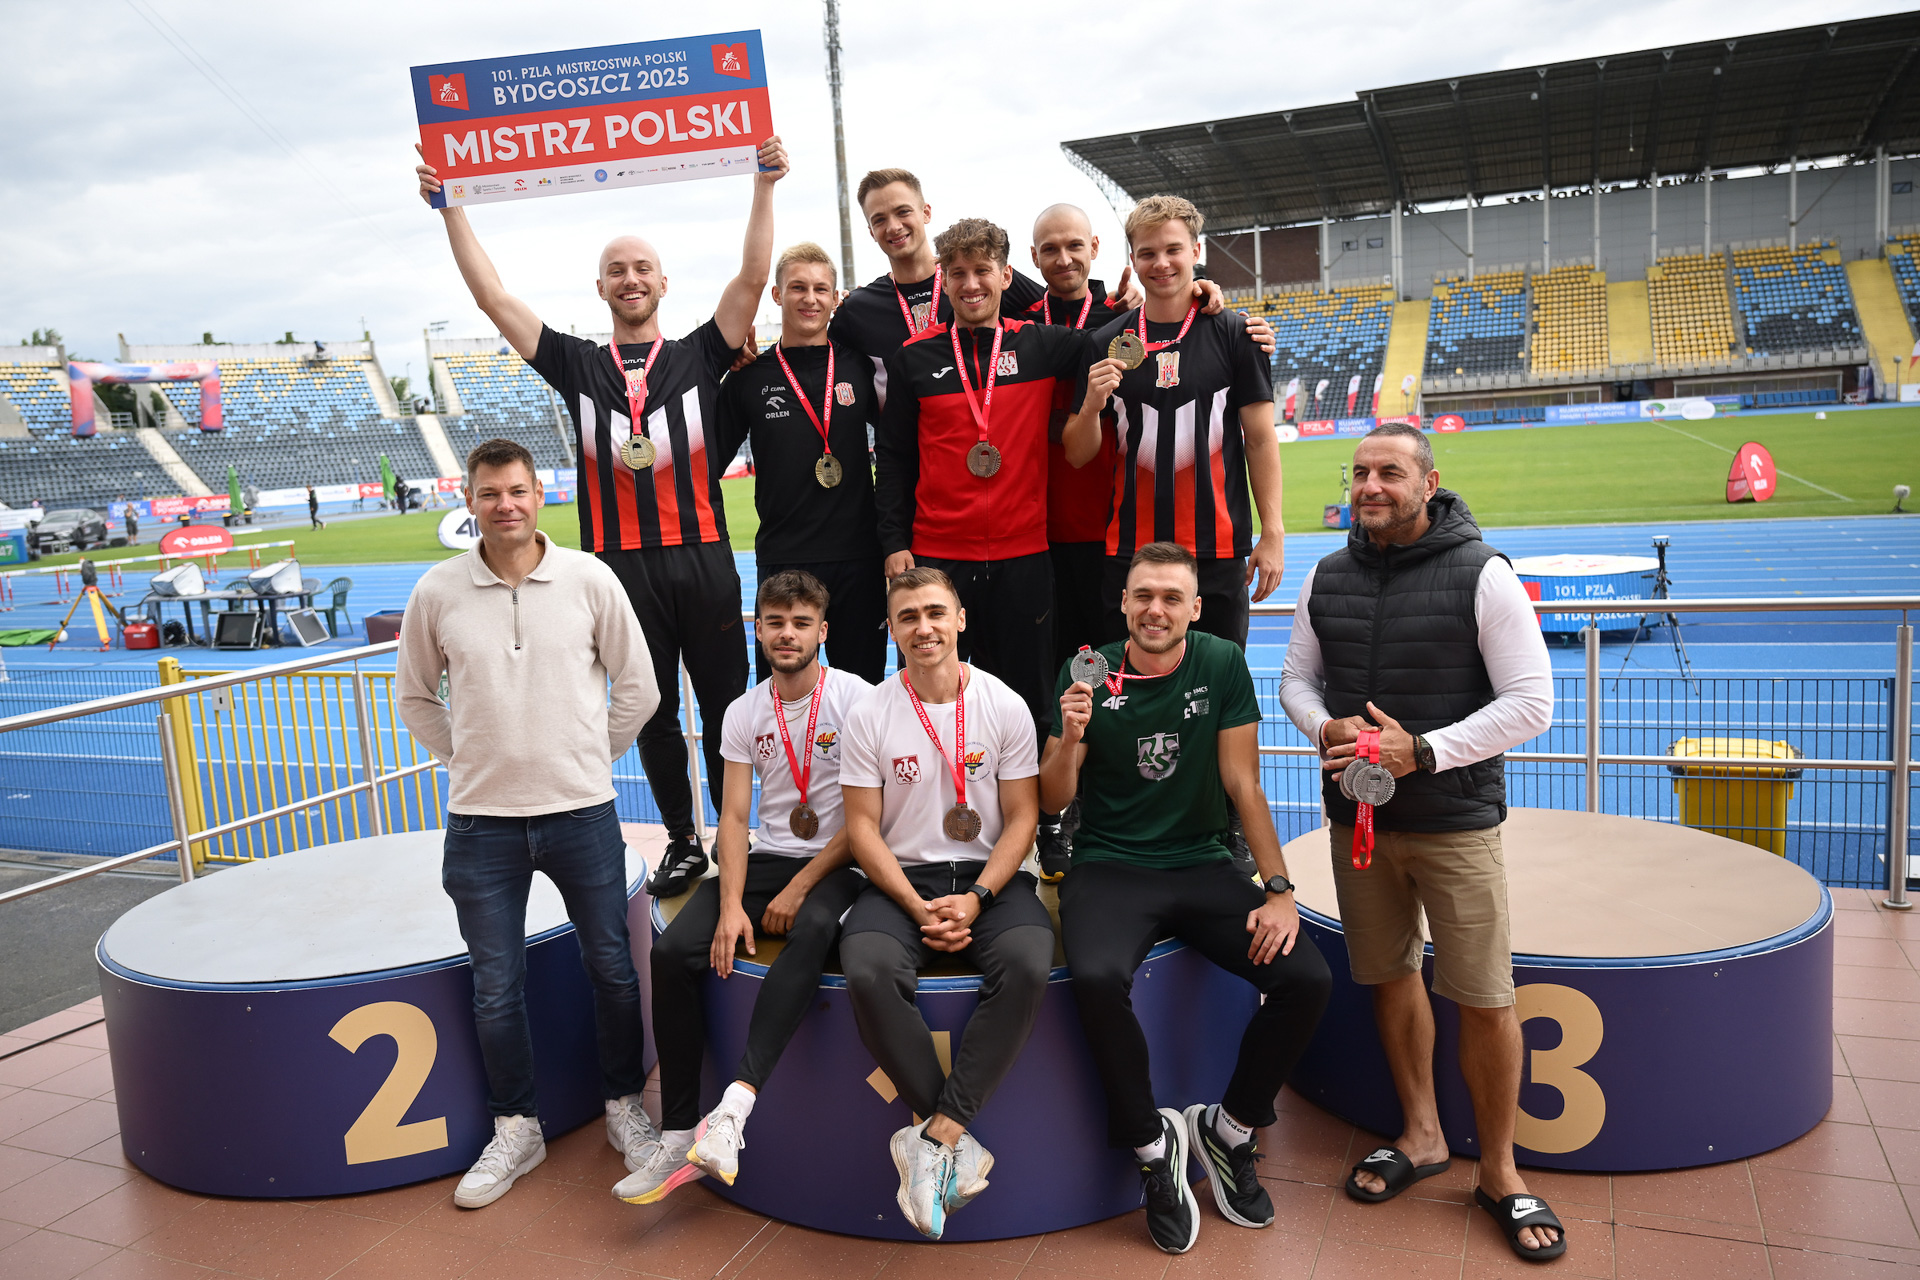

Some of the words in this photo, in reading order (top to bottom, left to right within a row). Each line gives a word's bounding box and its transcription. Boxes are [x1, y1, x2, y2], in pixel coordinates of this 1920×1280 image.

[491, 70, 518, 83] 101.
[521, 65, 552, 80] PZLA
[556, 55, 642, 76] MISTRZOSTWA
[644, 50, 687, 65] POLSKI
[493, 73, 632, 106] BYDGOSZCZ
[637, 66, 690, 90] 2025
[443, 117, 595, 168] MISTRZ
[604, 100, 752, 149] POLSKI
[1077, 300, 1091, 329] MISTRZOS
[953, 340, 967, 381] MISTRZOSTWA
[990, 327, 1002, 368] MISTRZOSTWA
[782, 362, 805, 400] MISTRZOSTWA
[987, 368, 996, 391] POLSKI
[765, 410, 790, 419] ORLEN
[1303, 423, 1333, 432] PZLA
[190, 534, 223, 546] ORLEN
[1554, 585, 1581, 597] 101.
[1585, 583, 1615, 597] PZLA
[808, 684, 822, 729] MISTRZOSTWA
[906, 683, 930, 728] MISTRZOSTWA
[926, 726, 942, 749] POLSKI
[1101, 695, 1129, 710] 4F
[774, 698, 789, 742] MISTRZOSTWA
[806, 729, 814, 752] POLSKI
[328, 1000, 449, 1166] 2
[1513, 983, 1606, 1154] 3
[1221, 1113, 1248, 1135] adidas
[1514, 1198, 1538, 1210] NIKE
